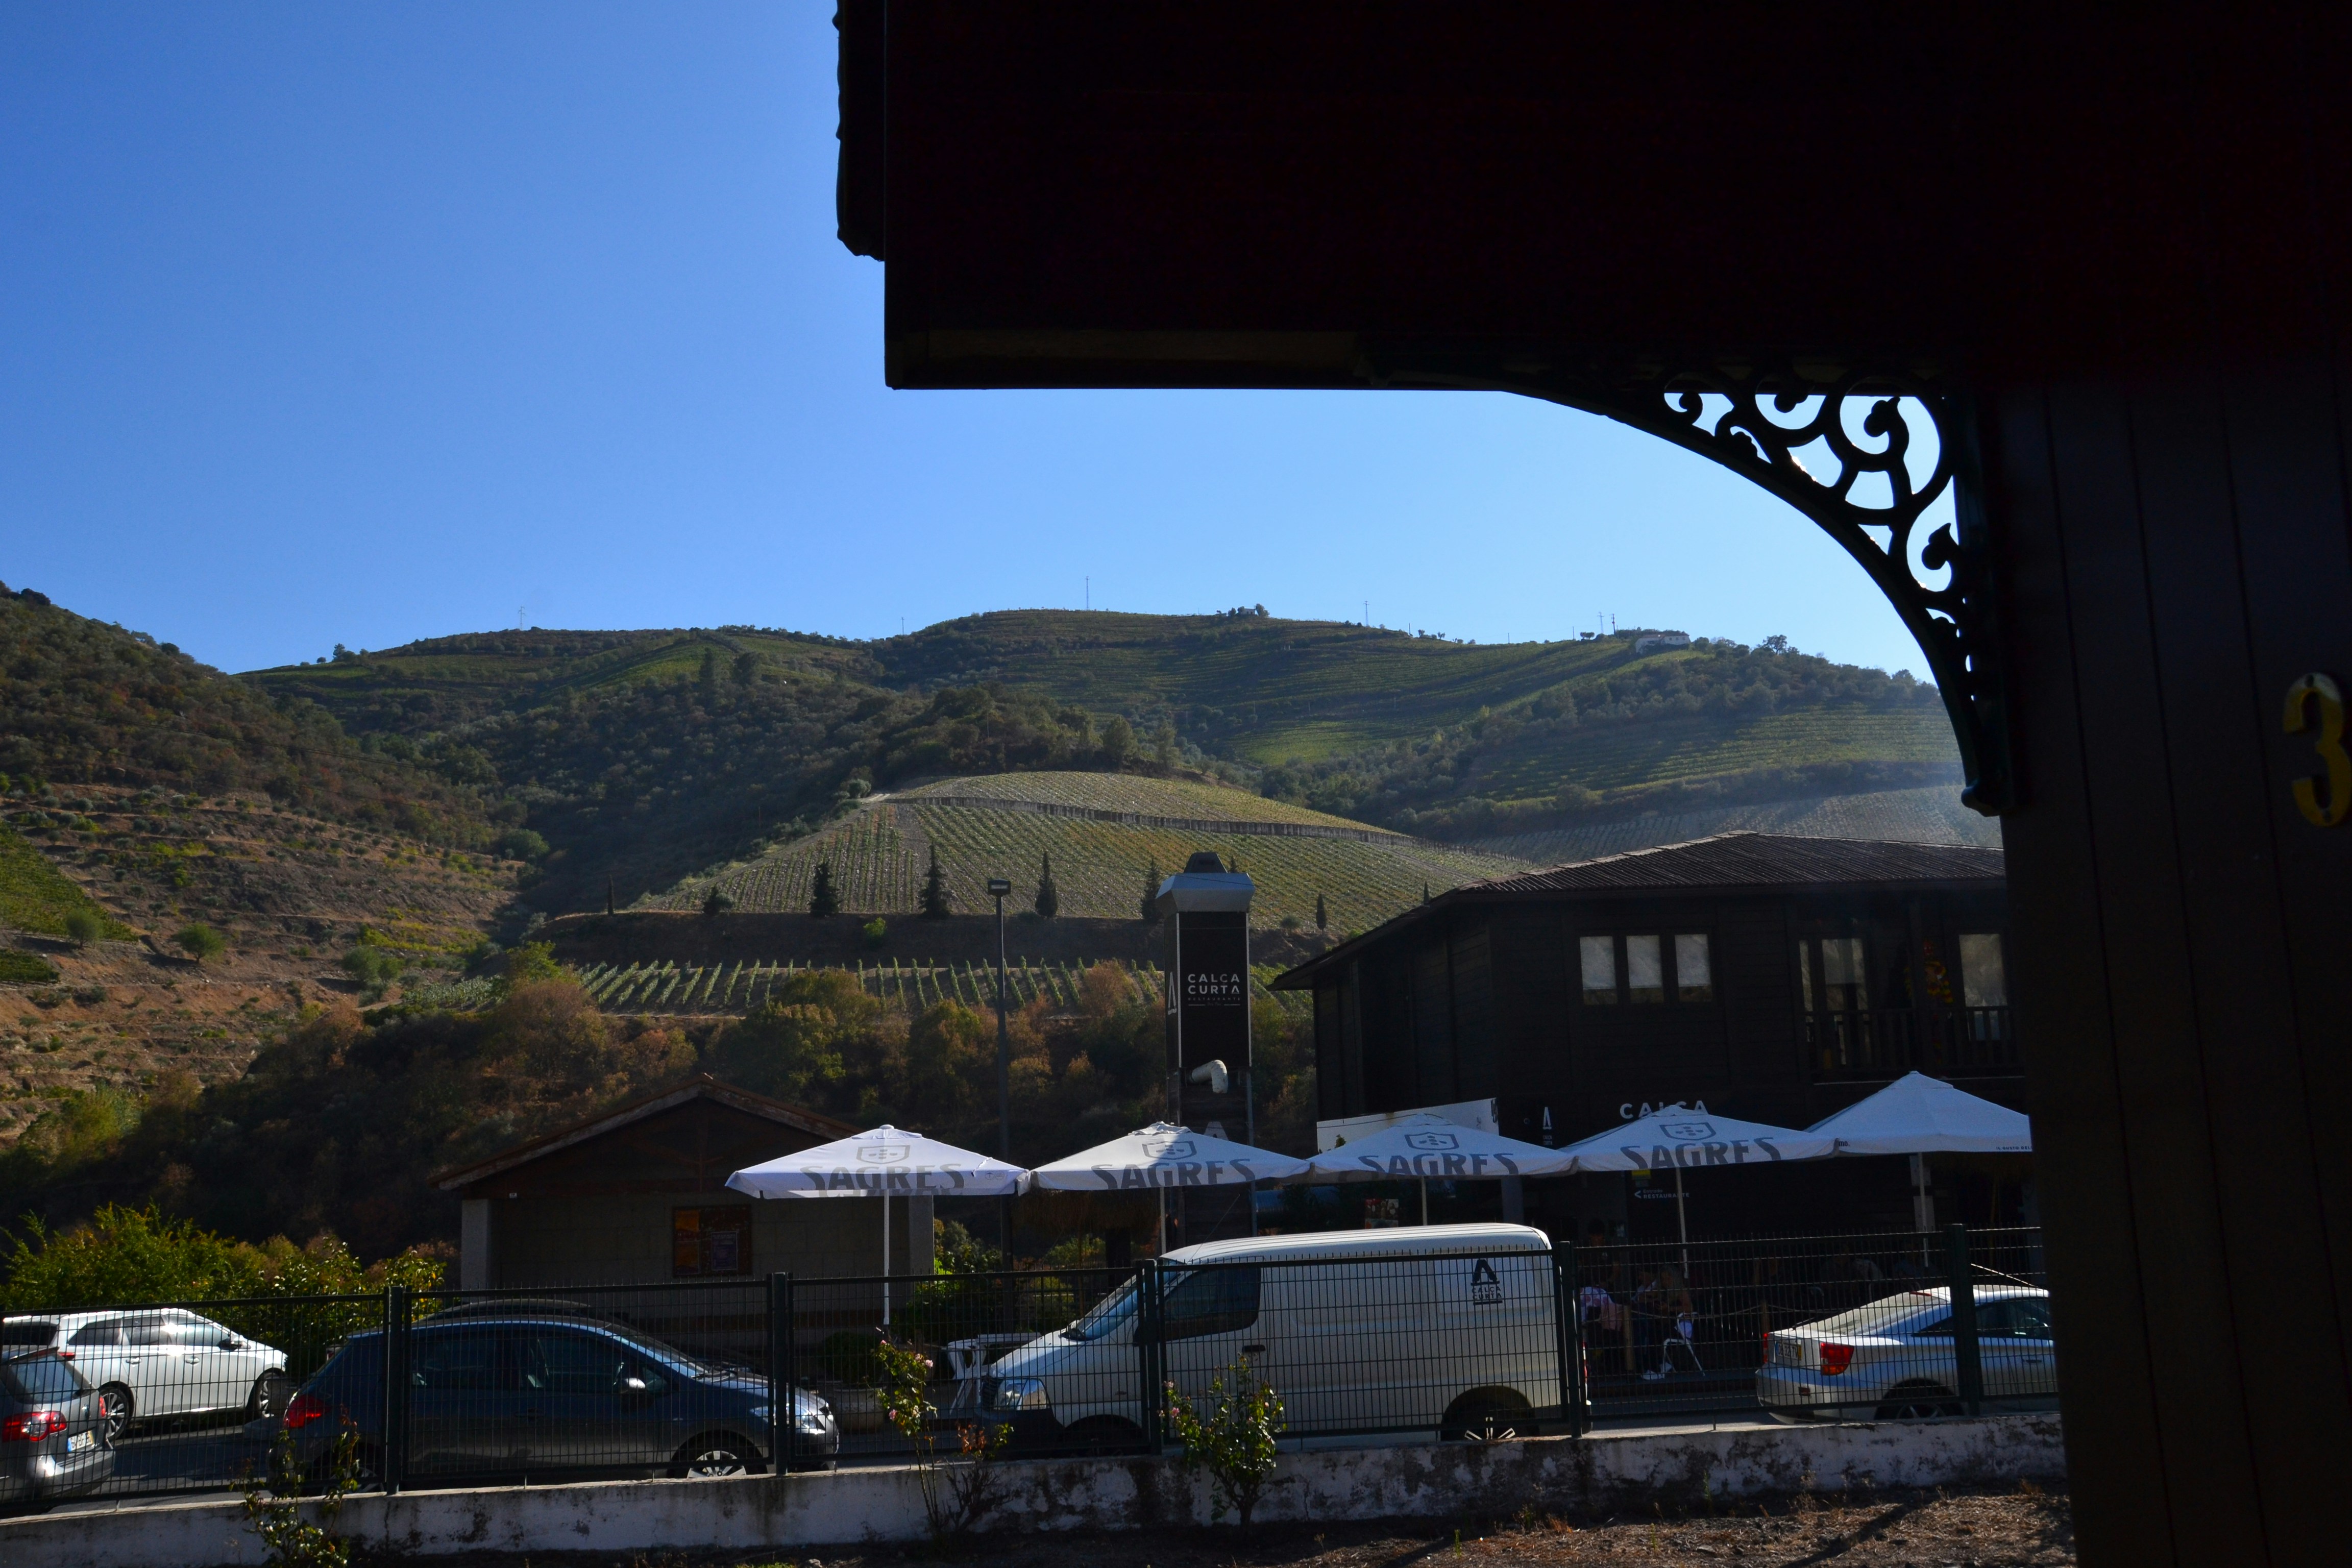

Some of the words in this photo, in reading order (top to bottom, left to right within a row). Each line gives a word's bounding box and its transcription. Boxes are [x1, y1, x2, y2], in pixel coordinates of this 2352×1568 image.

[2283, 672, 2352, 828] 3
[1188, 985, 1240, 994] CURTA
[1358, 1153, 1519, 1175] SAGRES
[1620, 1137, 1781, 1169] SAGRES
[800, 1163, 965, 1190] SAGRES
[1091, 1159, 1255, 1189] SAGRES
